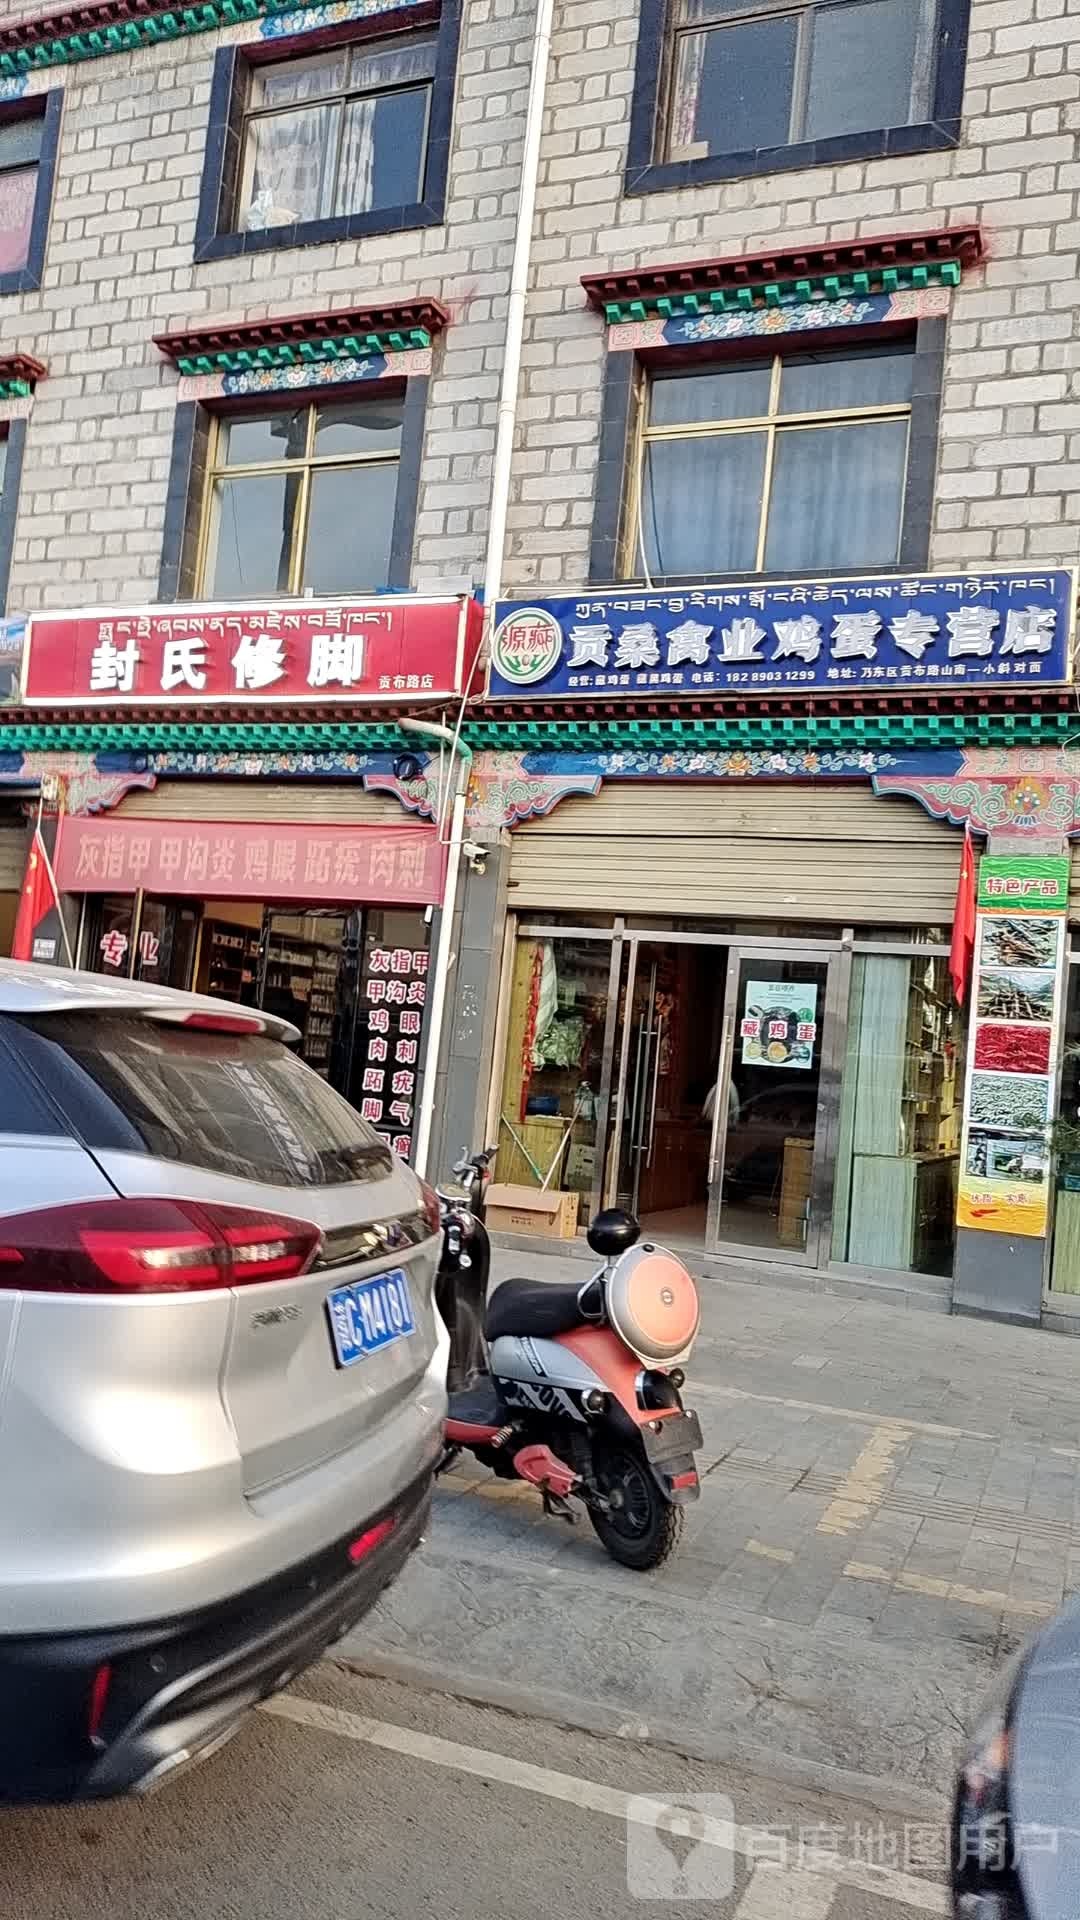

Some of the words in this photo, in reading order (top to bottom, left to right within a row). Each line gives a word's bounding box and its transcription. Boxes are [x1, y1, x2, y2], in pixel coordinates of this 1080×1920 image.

[567, 605, 1057, 668] 贡桑禽业鸡蛋专营店
[90, 633, 363, 691] 封氏修脚
[378, 673, 435, 690] 贡布路店
[726, 672, 748, 682] 182
[751, 671, 782, 682] 8903
[785, 670, 815, 681] 1299
[986, 877, 1059, 896] 特色产品
[369, 948, 430, 974] 灰指甲
[366, 979, 427, 1005] 甲沟炎
[368, 1008, 421, 1034] 鸡眼
[741, 1018, 816, 1042] 藏鸡蛋
[367, 1038, 418, 1064] 肉刺
[361, 1097, 411, 1125] 脚气
